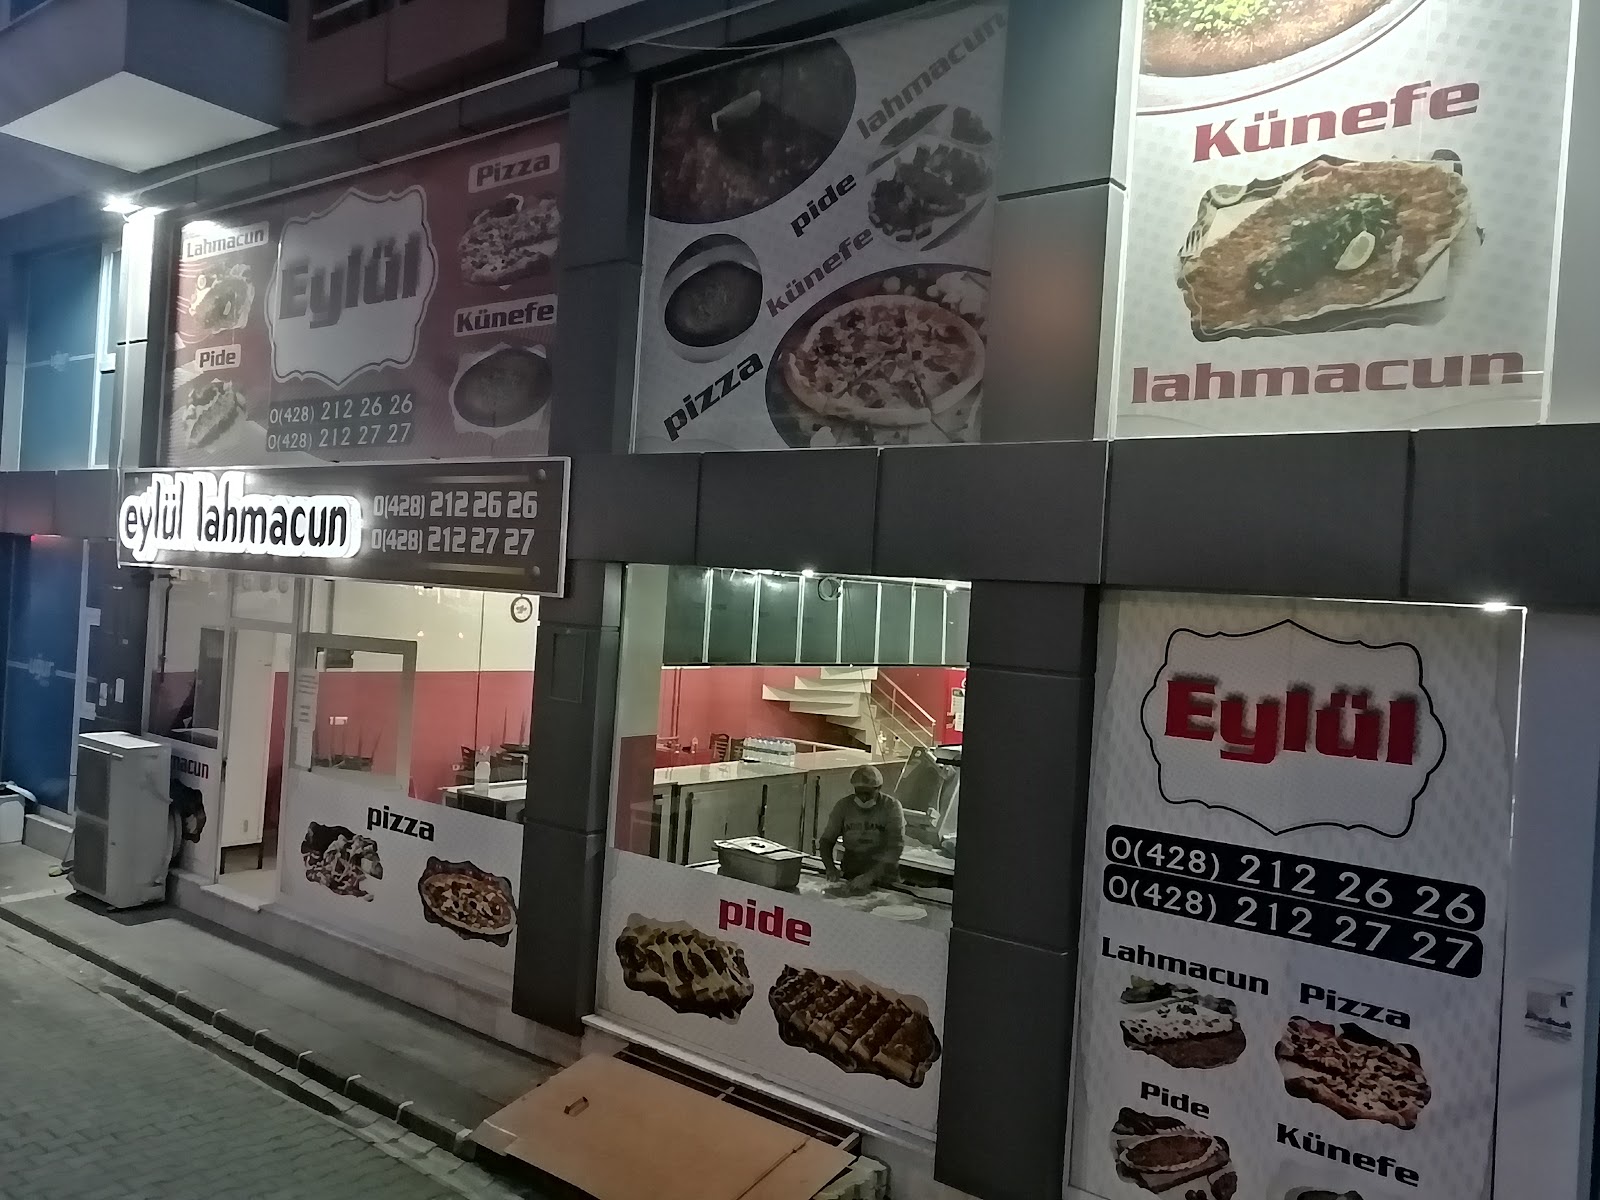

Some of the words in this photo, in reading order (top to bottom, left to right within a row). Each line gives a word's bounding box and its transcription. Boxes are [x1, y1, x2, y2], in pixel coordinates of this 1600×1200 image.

[856, 12, 1005, 139] lahmacun
[1193, 81, 1480, 163] Künefe
[475, 153, 551, 187] Pizza
[790, 173, 857, 238] pide
[186, 229, 265, 258] Lahmacun
[278, 229, 422, 330] Eylül
[765, 227, 874, 318] künefe
[456, 303, 555, 334] Künefe
[199, 349, 237, 369] Pide
[1131, 351, 1524, 404] lahmacun
[269, 405, 315, 425] 0(428)
[321, 399, 354, 421] 212
[361, 396, 383, 416] 26
[389, 394, 413, 415] 26
[663, 352, 764, 441] pizza
[267, 433, 312, 451] 0(428)
[318, 428, 350, 448] 212
[358, 424, 380, 446] 27
[386, 423, 412, 444] 27
[125, 480, 185, 552] eylül
[197, 480, 347, 547] lahmacun
[373, 493, 426, 522] 0(428)
[429, 492, 469, 517] 212
[472, 492, 502, 518] 26
[506, 490, 538, 519] 26
[371, 528, 423, 555] 0(428)
[427, 527, 466, 551] 212
[470, 528, 499, 554] 27
[503, 528, 535, 555] 27
[1164, 673, 1421, 766] Eylül
[367, 804, 435, 842] pizza
[1110, 835, 1221, 882] 0(428)
[1237, 853, 1317, 896] 212
[1335, 870, 1394, 910] 26
[1412, 885, 1476, 925] 26
[718, 898, 813, 947] pide
[1107, 874, 1218, 923] 0(428)
[1234, 895, 1314, 939] 212
[1331, 915, 1392, 953] 27
[1409, 930, 1474, 972] 27
[1101, 936, 1270, 996] Lahmacun
[1299, 982, 1412, 1030] Pizza
[1140, 1081, 1211, 1120] Pide
[1276, 1122, 1421, 1188] Künefe
